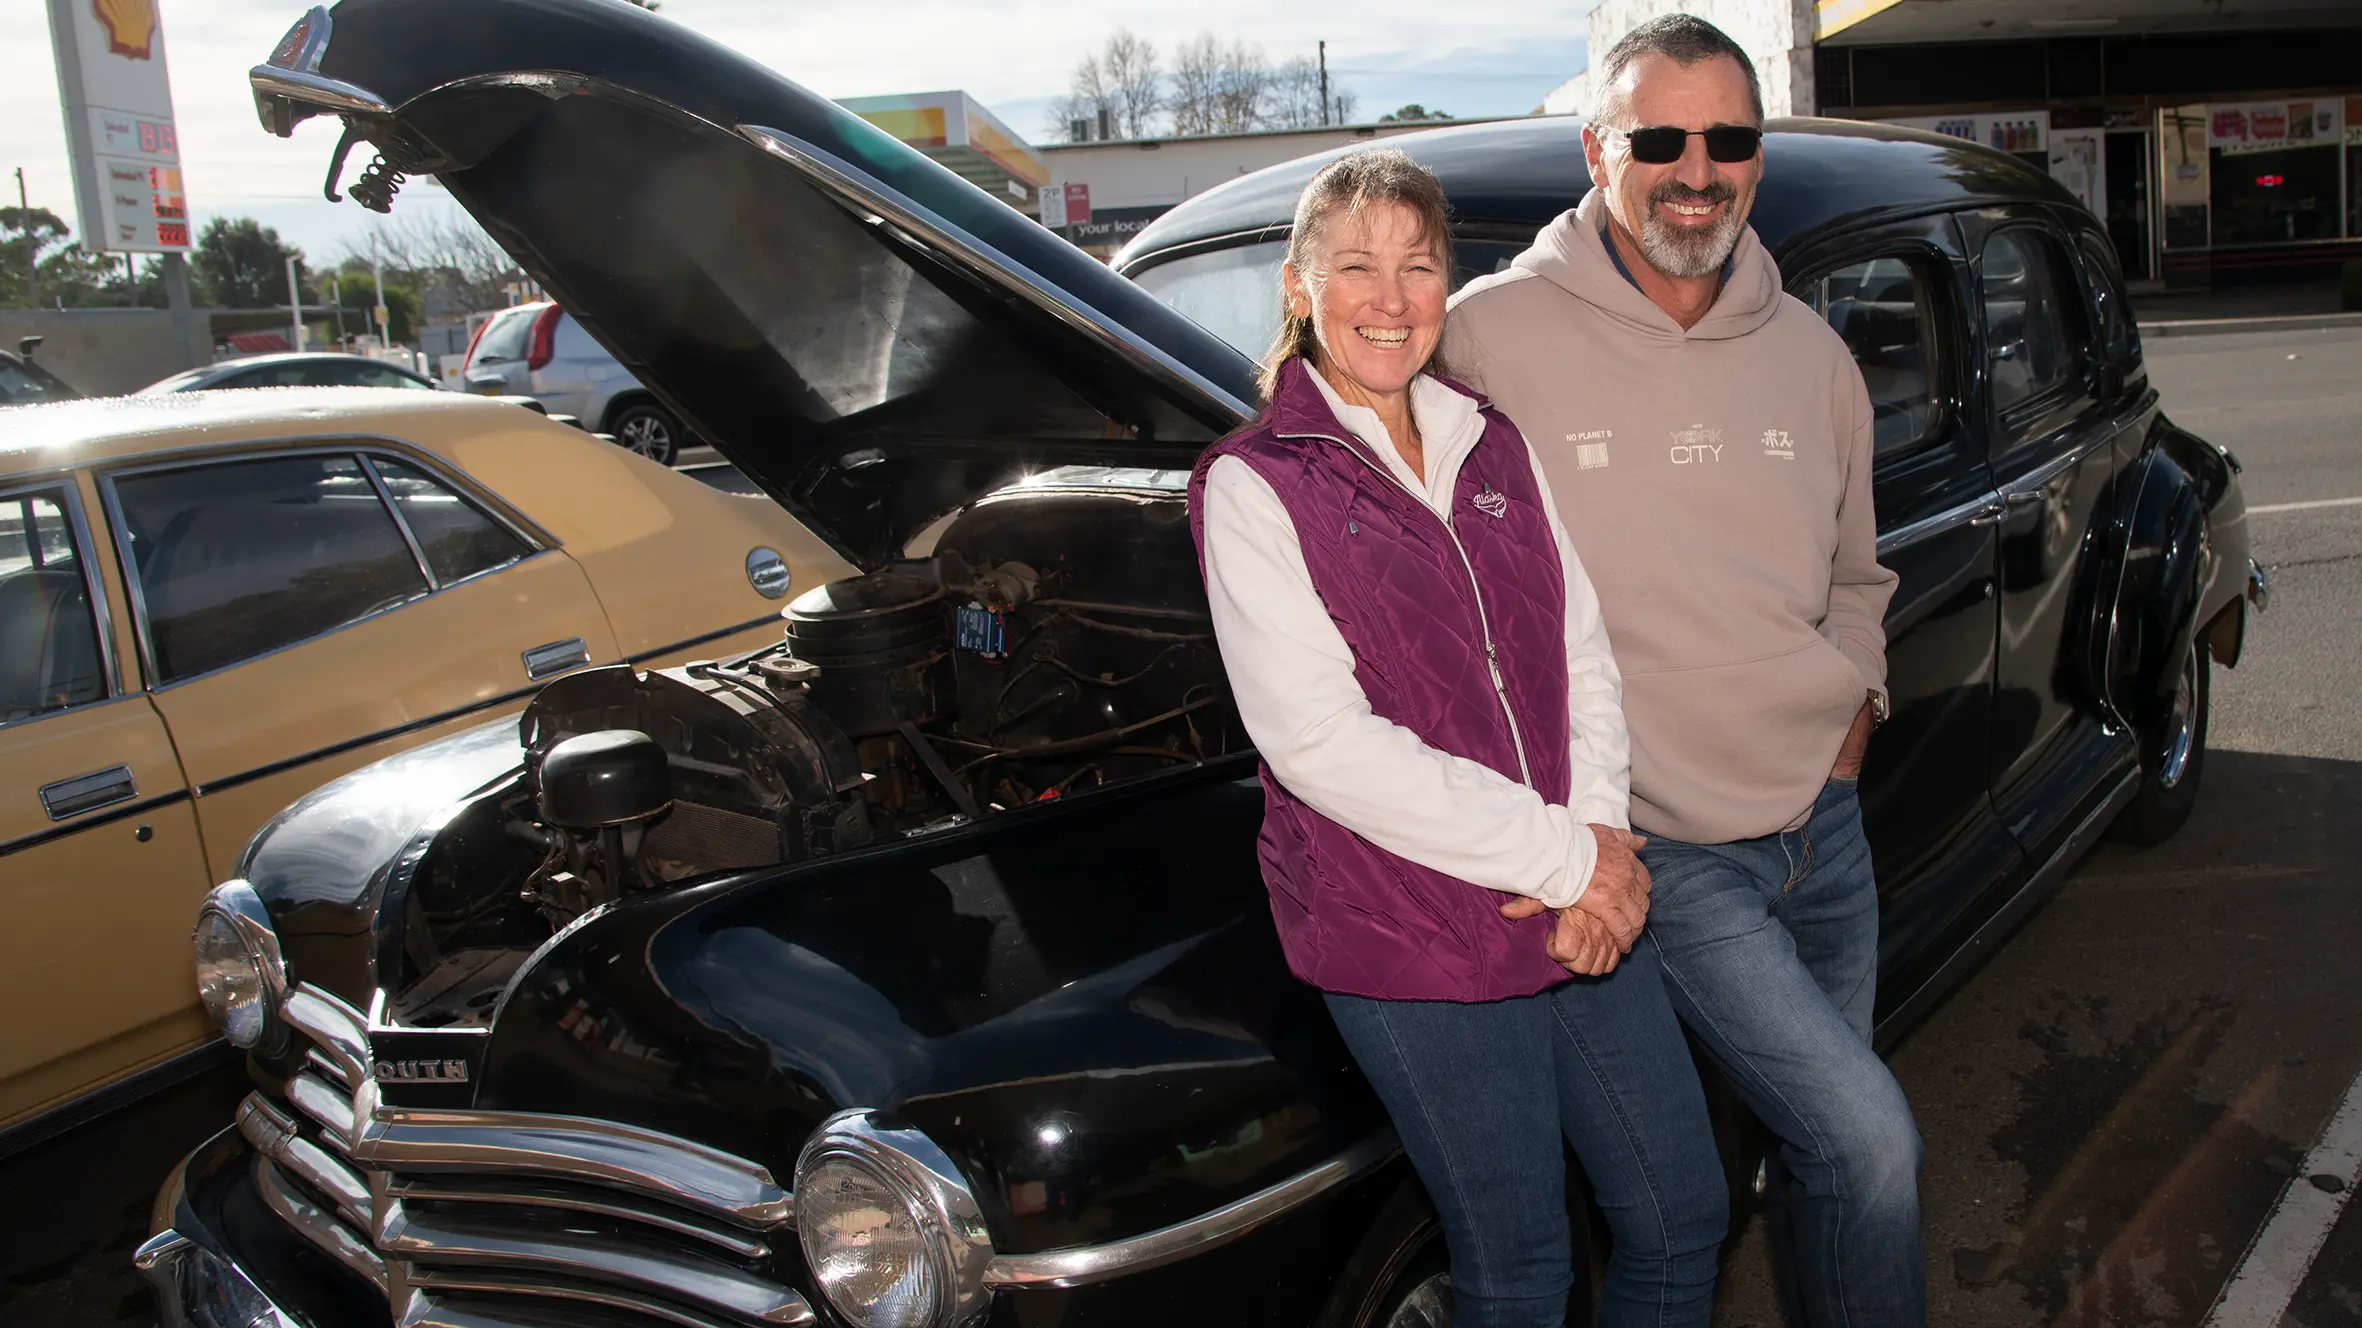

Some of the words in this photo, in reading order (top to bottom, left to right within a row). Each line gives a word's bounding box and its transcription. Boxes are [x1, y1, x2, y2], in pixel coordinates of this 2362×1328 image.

[1078, 223, 1111, 238] your
[1566, 433, 1577, 442] NO
[1578, 430, 1605, 440] PLANET
[1607, 430, 1613, 438] B
[1670, 444, 1723, 464] CITY
